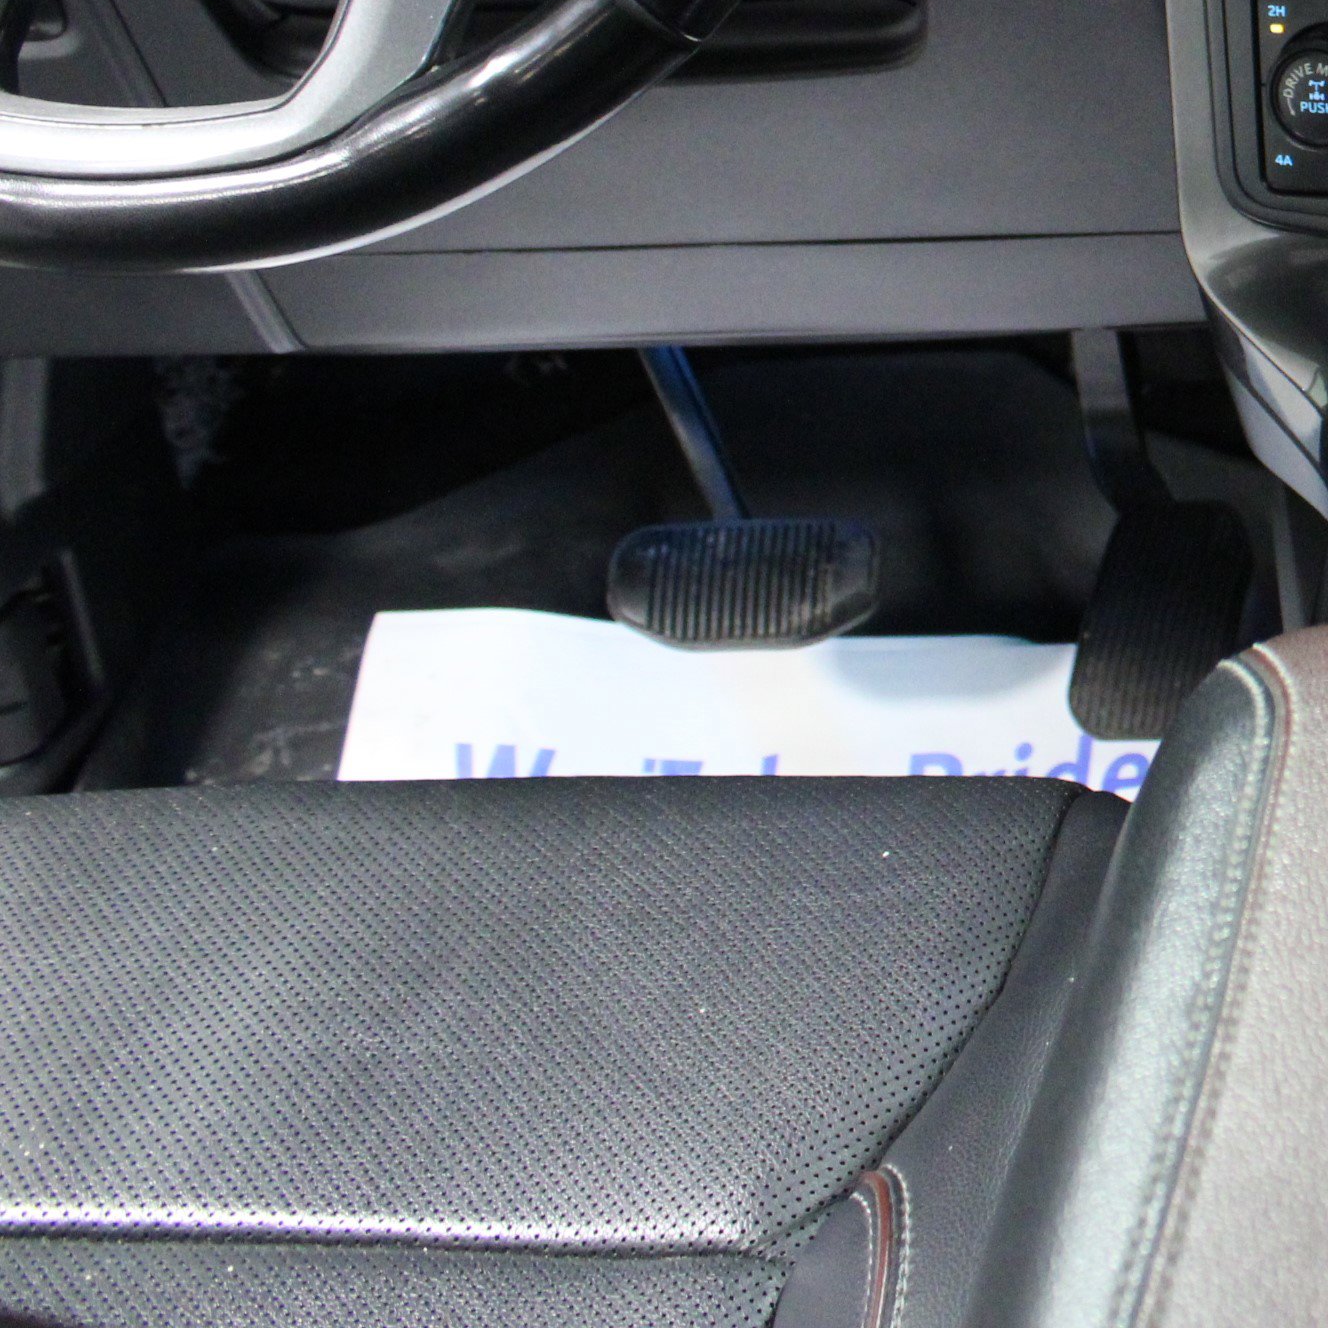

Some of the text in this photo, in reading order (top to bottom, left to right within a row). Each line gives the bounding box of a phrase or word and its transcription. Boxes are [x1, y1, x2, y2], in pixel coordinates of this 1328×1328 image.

[1267, 5, 1287, 18] 2H
[1282, 62, 1314, 100] DRIVE
[1275, 154, 1294, 168] 4A
